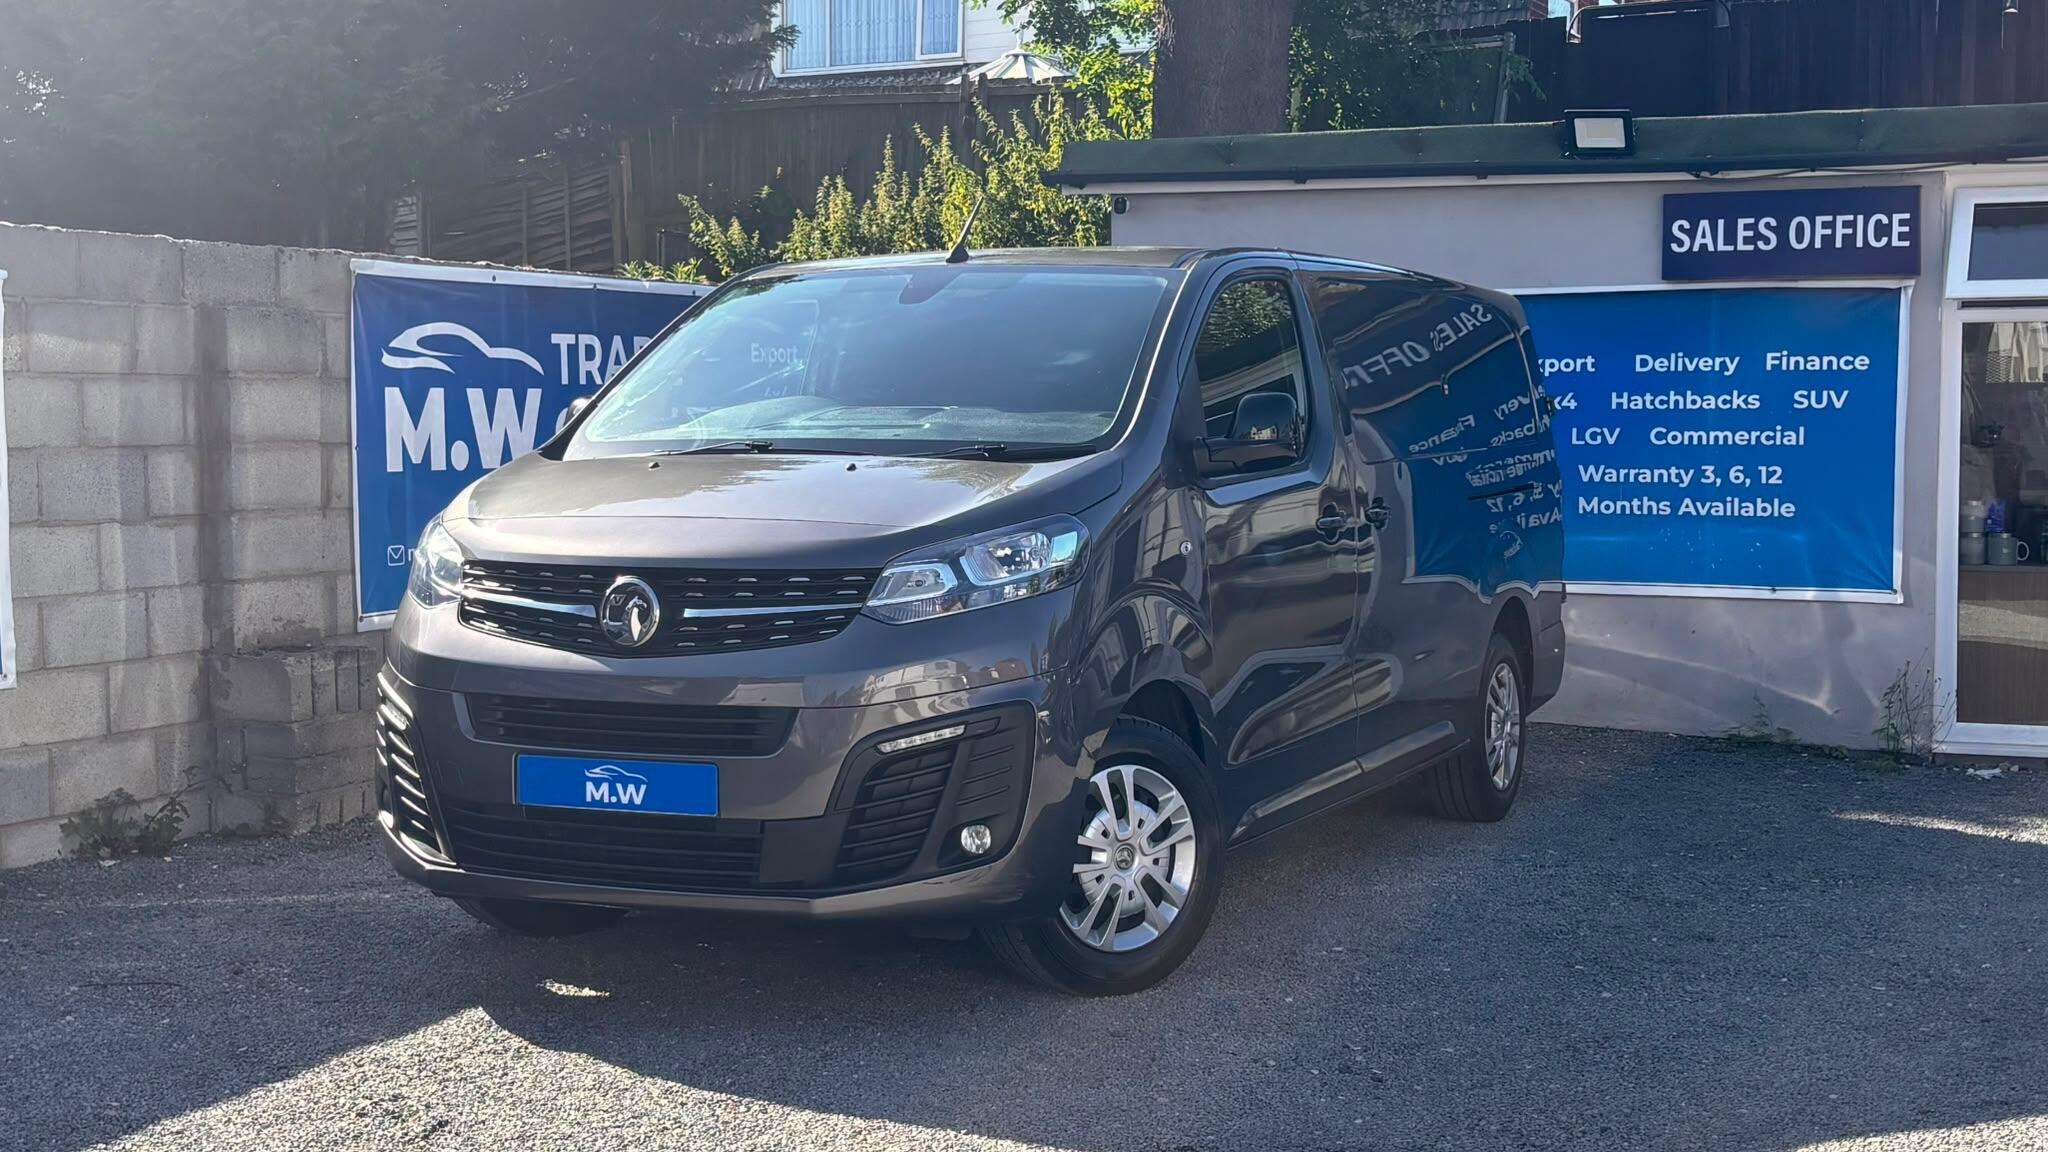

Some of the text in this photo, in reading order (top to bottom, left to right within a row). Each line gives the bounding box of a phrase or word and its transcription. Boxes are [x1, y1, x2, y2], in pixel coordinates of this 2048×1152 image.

[1670, 213, 1911, 253] SALES OFFICE
[1635, 352, 1740, 376] Delivery
[1765, 350, 1870, 372] Finance
[1611, 390, 1760, 410] Hatchbacks
[1793, 389, 1849, 409] SUV
[384, 387, 542, 472] M.W
[1571, 425, 1805, 446] LGV Commercial
[1578, 464, 1694, 488] Warranty
[1700, 465, 1722, 488] 3,
[1728, 465, 1751, 488] 6,
[1758, 465, 1783, 485] 12
[1578, 496, 1796, 518] Months Available
[585, 781, 647, 805] M.W
